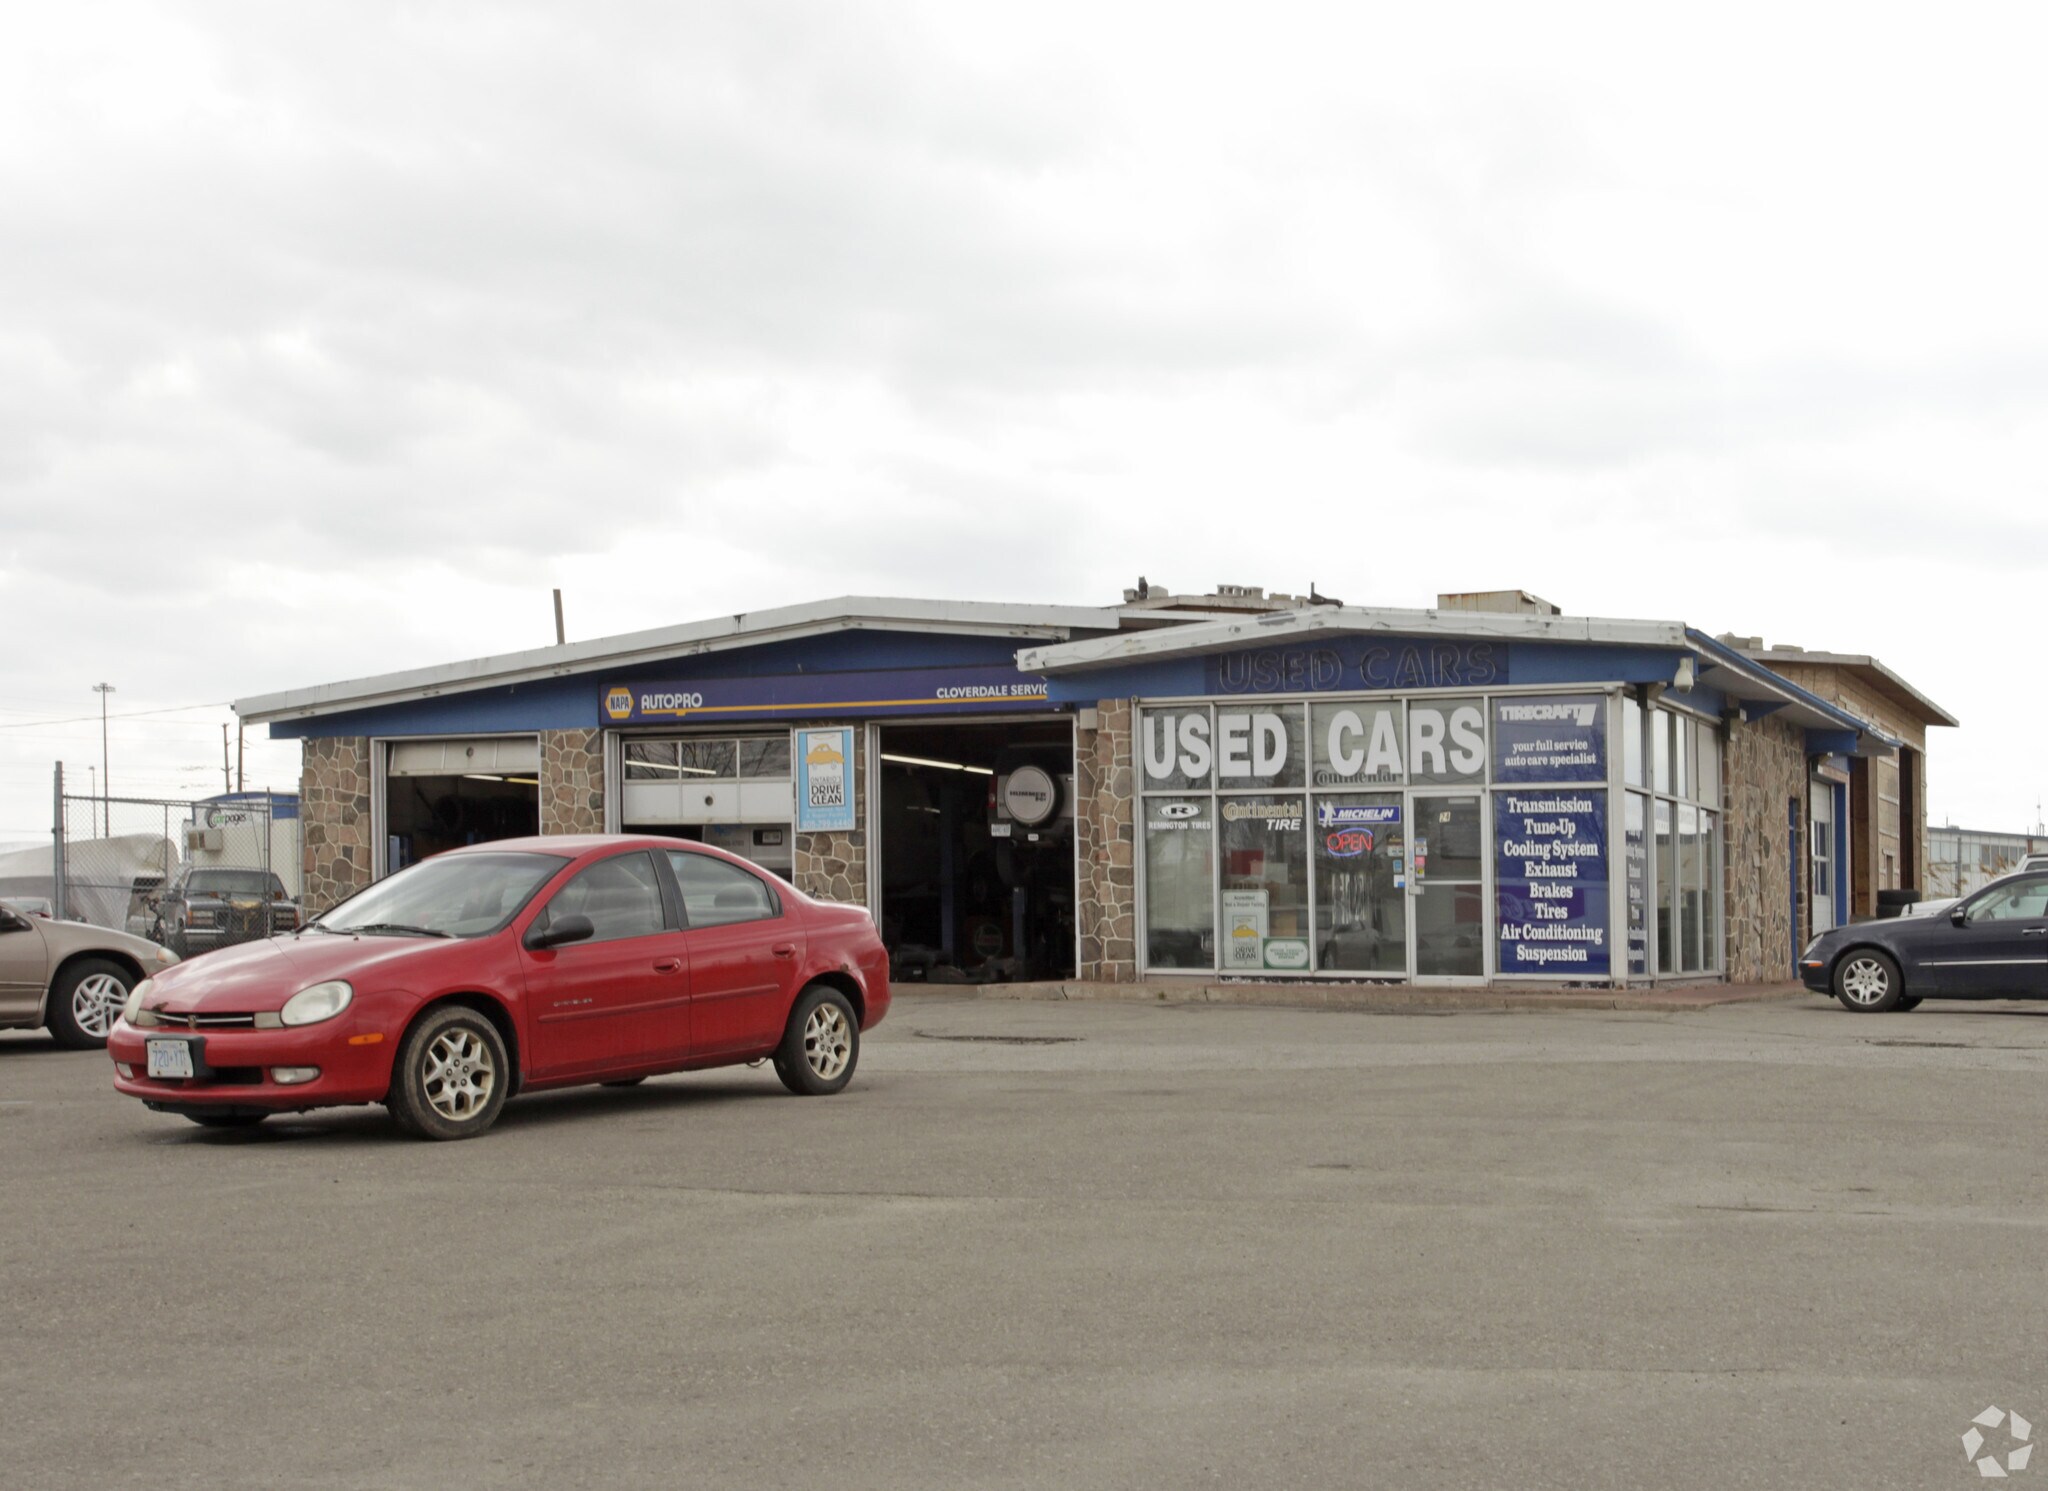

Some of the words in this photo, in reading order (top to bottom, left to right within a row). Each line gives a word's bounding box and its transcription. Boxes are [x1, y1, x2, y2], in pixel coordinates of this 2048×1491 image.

[1219, 649, 1343, 693] USED
[1359, 642, 1497, 689] CARS
[936, 684, 1008, 699] CLOVERDALE
[610, 695, 630, 710] NAPA
[641, 692, 703, 710] AUTOPRO
[1500, 704, 1586, 721] TIRECRAFT
[1143, 713, 1287, 780] USED
[1328, 706, 1486, 777] CARS
[1512, 742, 1535, 755] your
[1536, 739, 1553, 751] full
[1554, 739, 1588, 751] service
[1505, 755, 1527, 766] auto
[1527, 756, 1548, 766] care
[1550, 753, 1597, 768] specialist
[811, 784, 842, 795] DRIVE
[811, 794, 842, 805] CLEAN
[1507, 796, 1593, 814] Transmission
[1223, 800, 1303, 822] Continental
[1337, 808, 1394, 818] MICHELIN
[1148, 820, 1188, 830] REMINGTON
[1191, 820, 1211, 830] TIRES
[1266, 818, 1302, 831] TIRE
[1524, 818, 1577, 838] Tune-Up
[1326, 833, 1374, 851] OPEN
[1503, 839, 1551, 860] Cooling
[1552, 839, 1599, 860] System
[1524, 860, 1578, 878] Exhaust
[1529, 881, 1574, 898] Brakes
[1535, 902, 1568, 919] Tires
[1501, 923, 1522, 940] Air
[1522, 923, 1604, 945] Conditioning
[1516, 944, 1588, 965] Suspension
